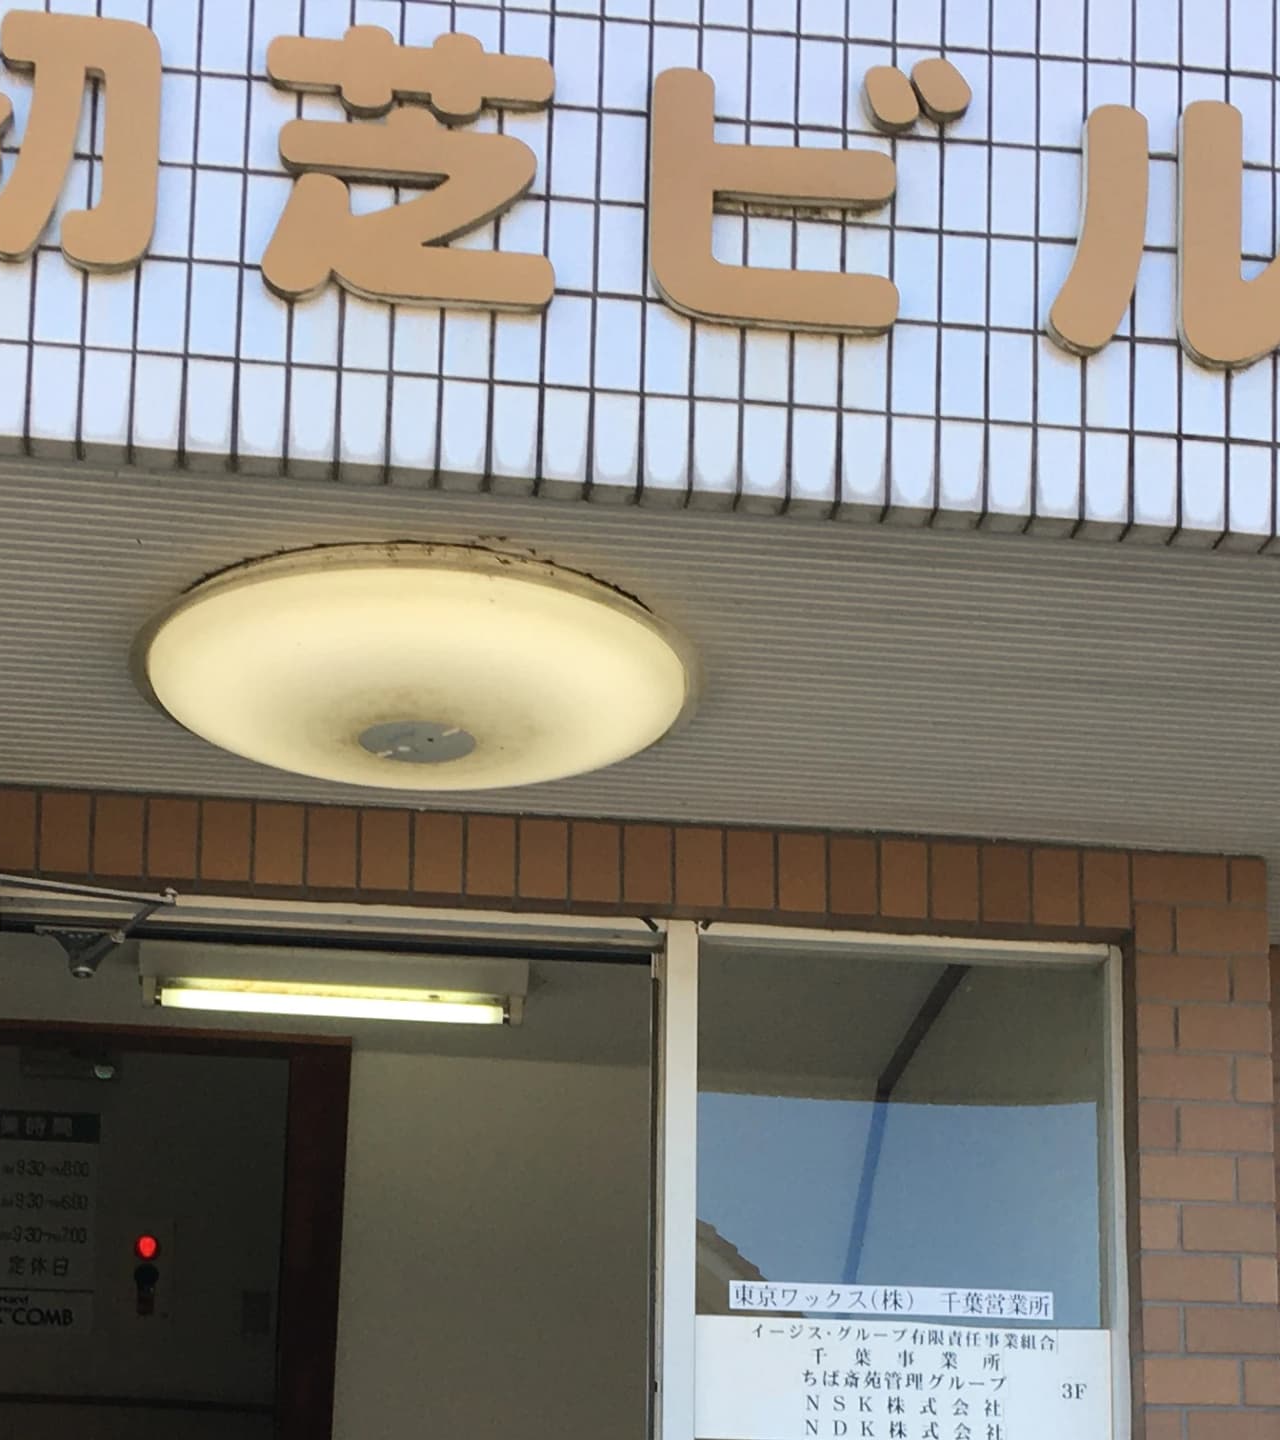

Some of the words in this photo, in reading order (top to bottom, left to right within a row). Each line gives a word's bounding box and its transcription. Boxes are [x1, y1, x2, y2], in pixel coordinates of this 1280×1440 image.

[943, 1290, 1051, 1317] 千葉営業所
[812, 1347, 1001, 1371] 千葉事業所
[1062, 1383, 1087, 1400] 3F
[805, 1395, 1002, 1418] NSK株式会社
